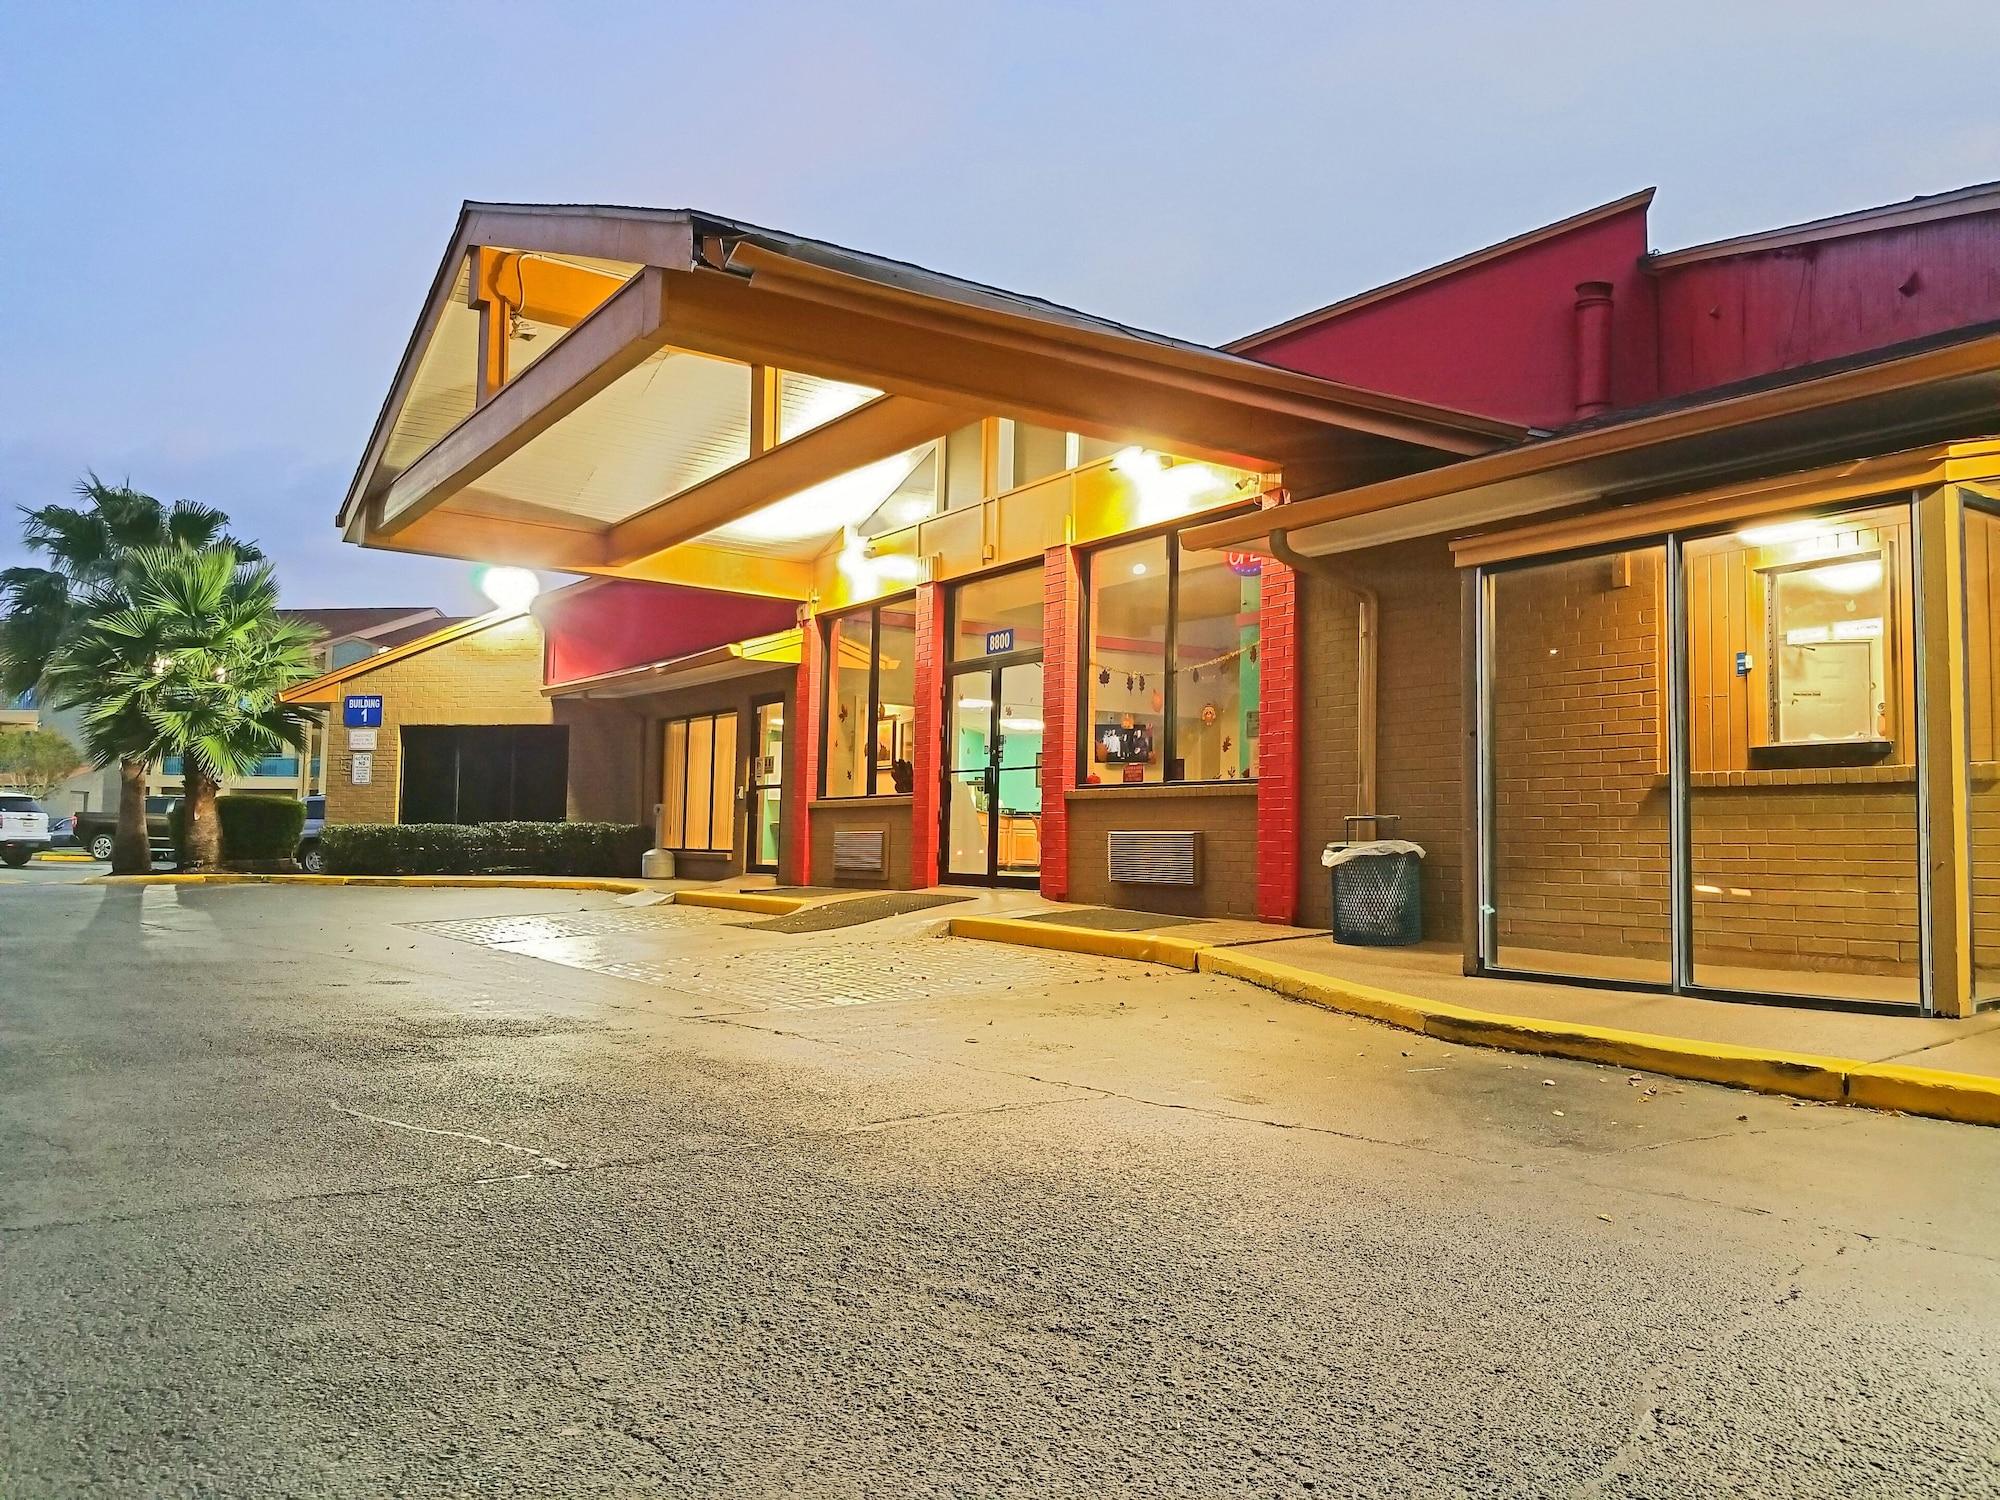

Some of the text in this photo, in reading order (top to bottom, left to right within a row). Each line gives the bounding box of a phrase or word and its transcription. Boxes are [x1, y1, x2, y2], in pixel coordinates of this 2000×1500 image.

[990, 632, 1010, 651] 8800
[349, 699, 380, 709] BUILDING
[361, 709, 368, 722] 1
